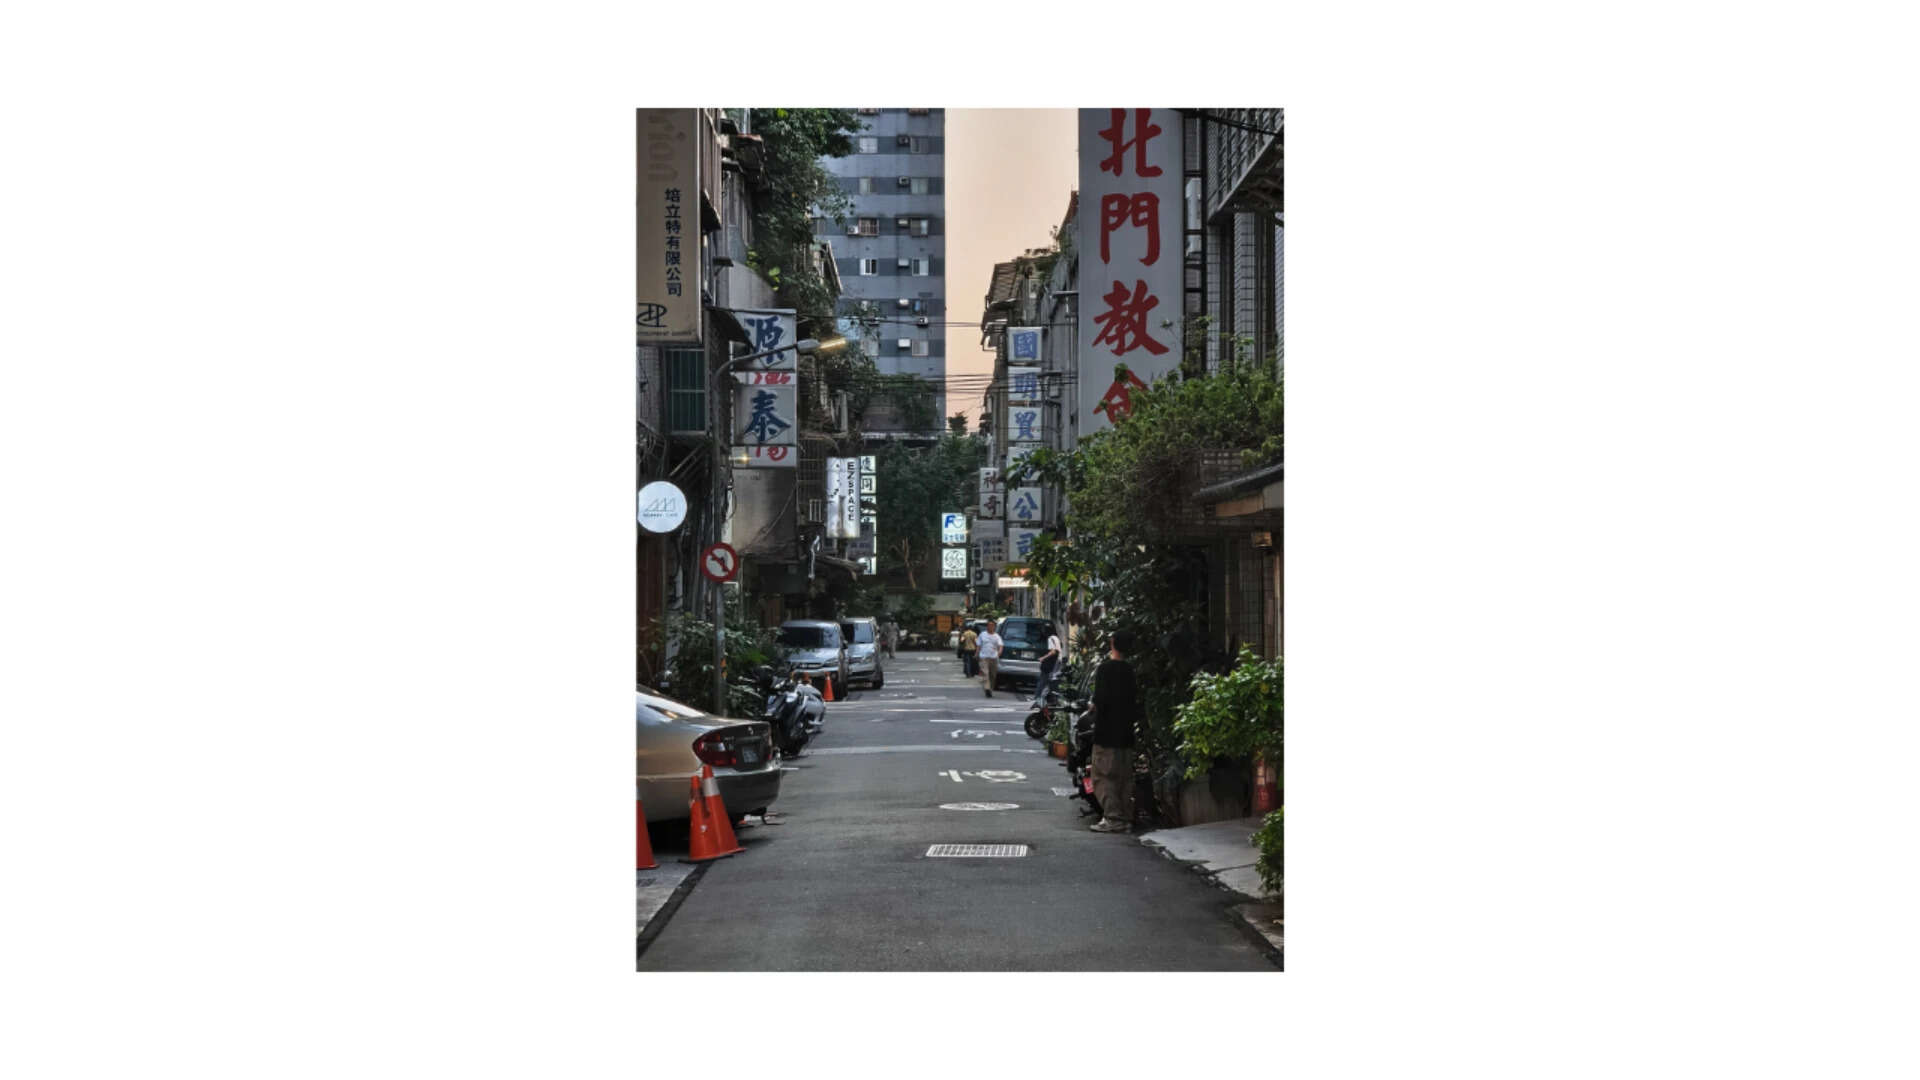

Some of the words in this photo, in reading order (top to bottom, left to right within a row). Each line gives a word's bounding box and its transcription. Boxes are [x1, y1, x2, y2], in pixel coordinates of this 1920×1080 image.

[665, 187, 682, 297] 培立特有限公司
[847, 461, 856, 521] EZSPACE
